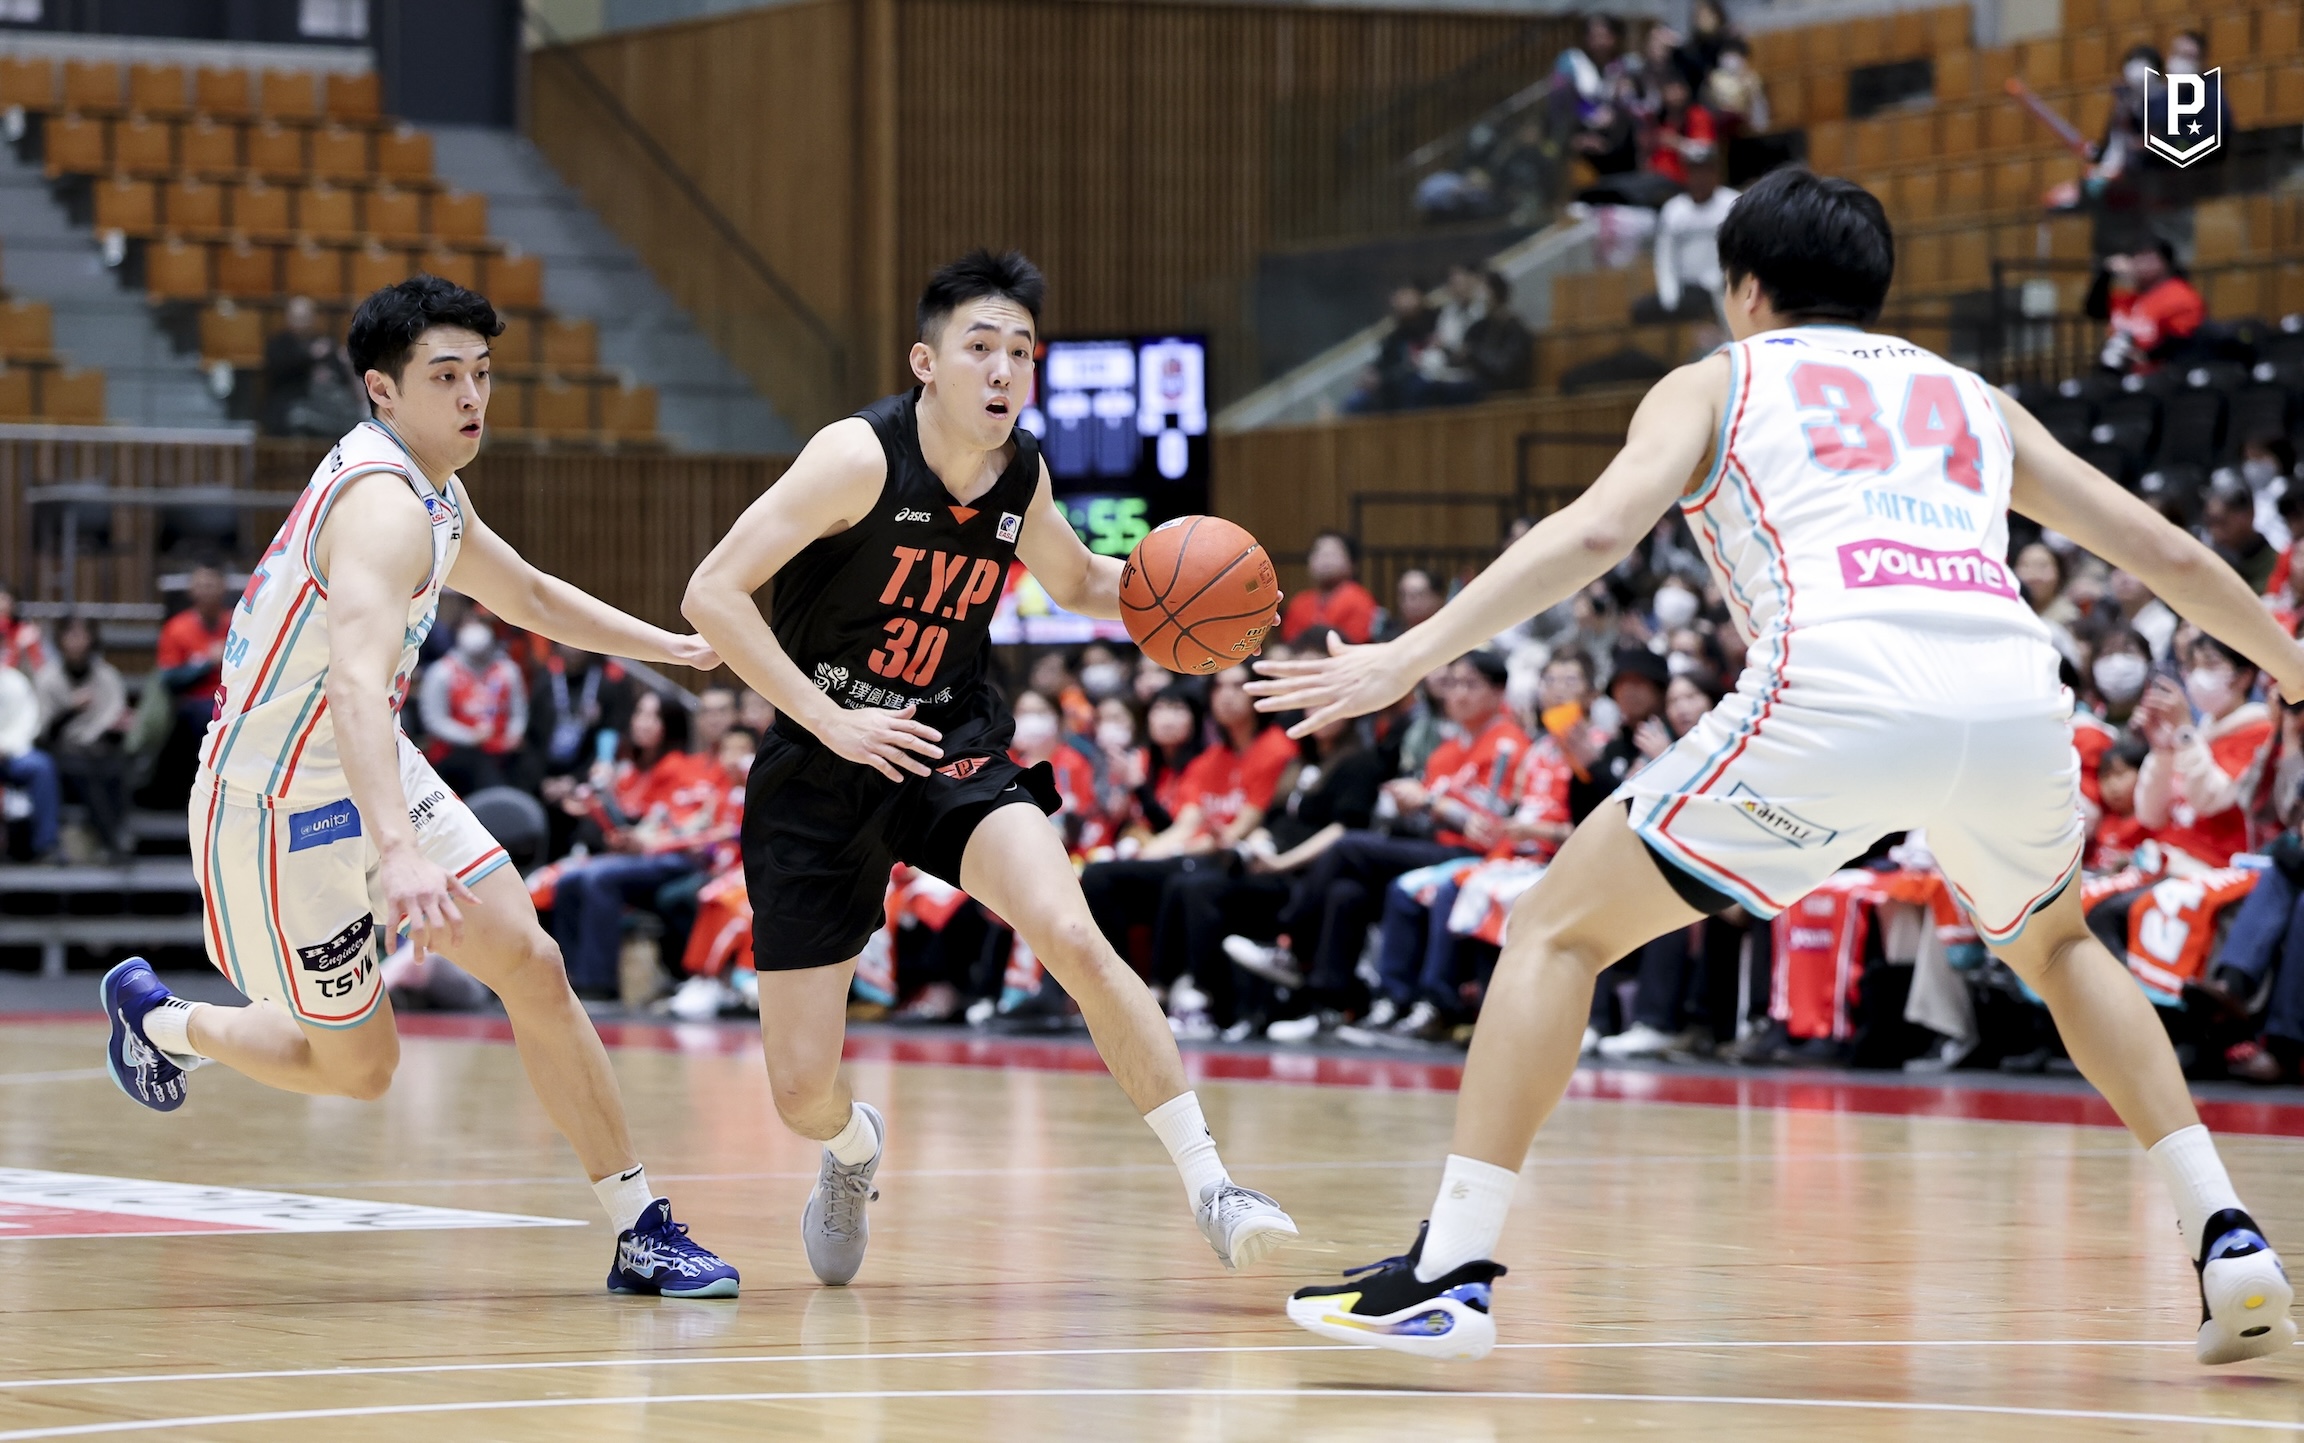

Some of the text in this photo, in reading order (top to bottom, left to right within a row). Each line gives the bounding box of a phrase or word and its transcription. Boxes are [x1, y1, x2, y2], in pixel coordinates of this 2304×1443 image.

[1786, 360, 1985, 495] 34
[1862, 489, 1977, 533] MITANI
[998, 530, 1015, 541] EASL
[1851, 547, 2004, 590] youme
[867, 617, 950, 688] 30
[312, 812, 351, 832] unitar
[409, 790, 446, 824] SHINO
